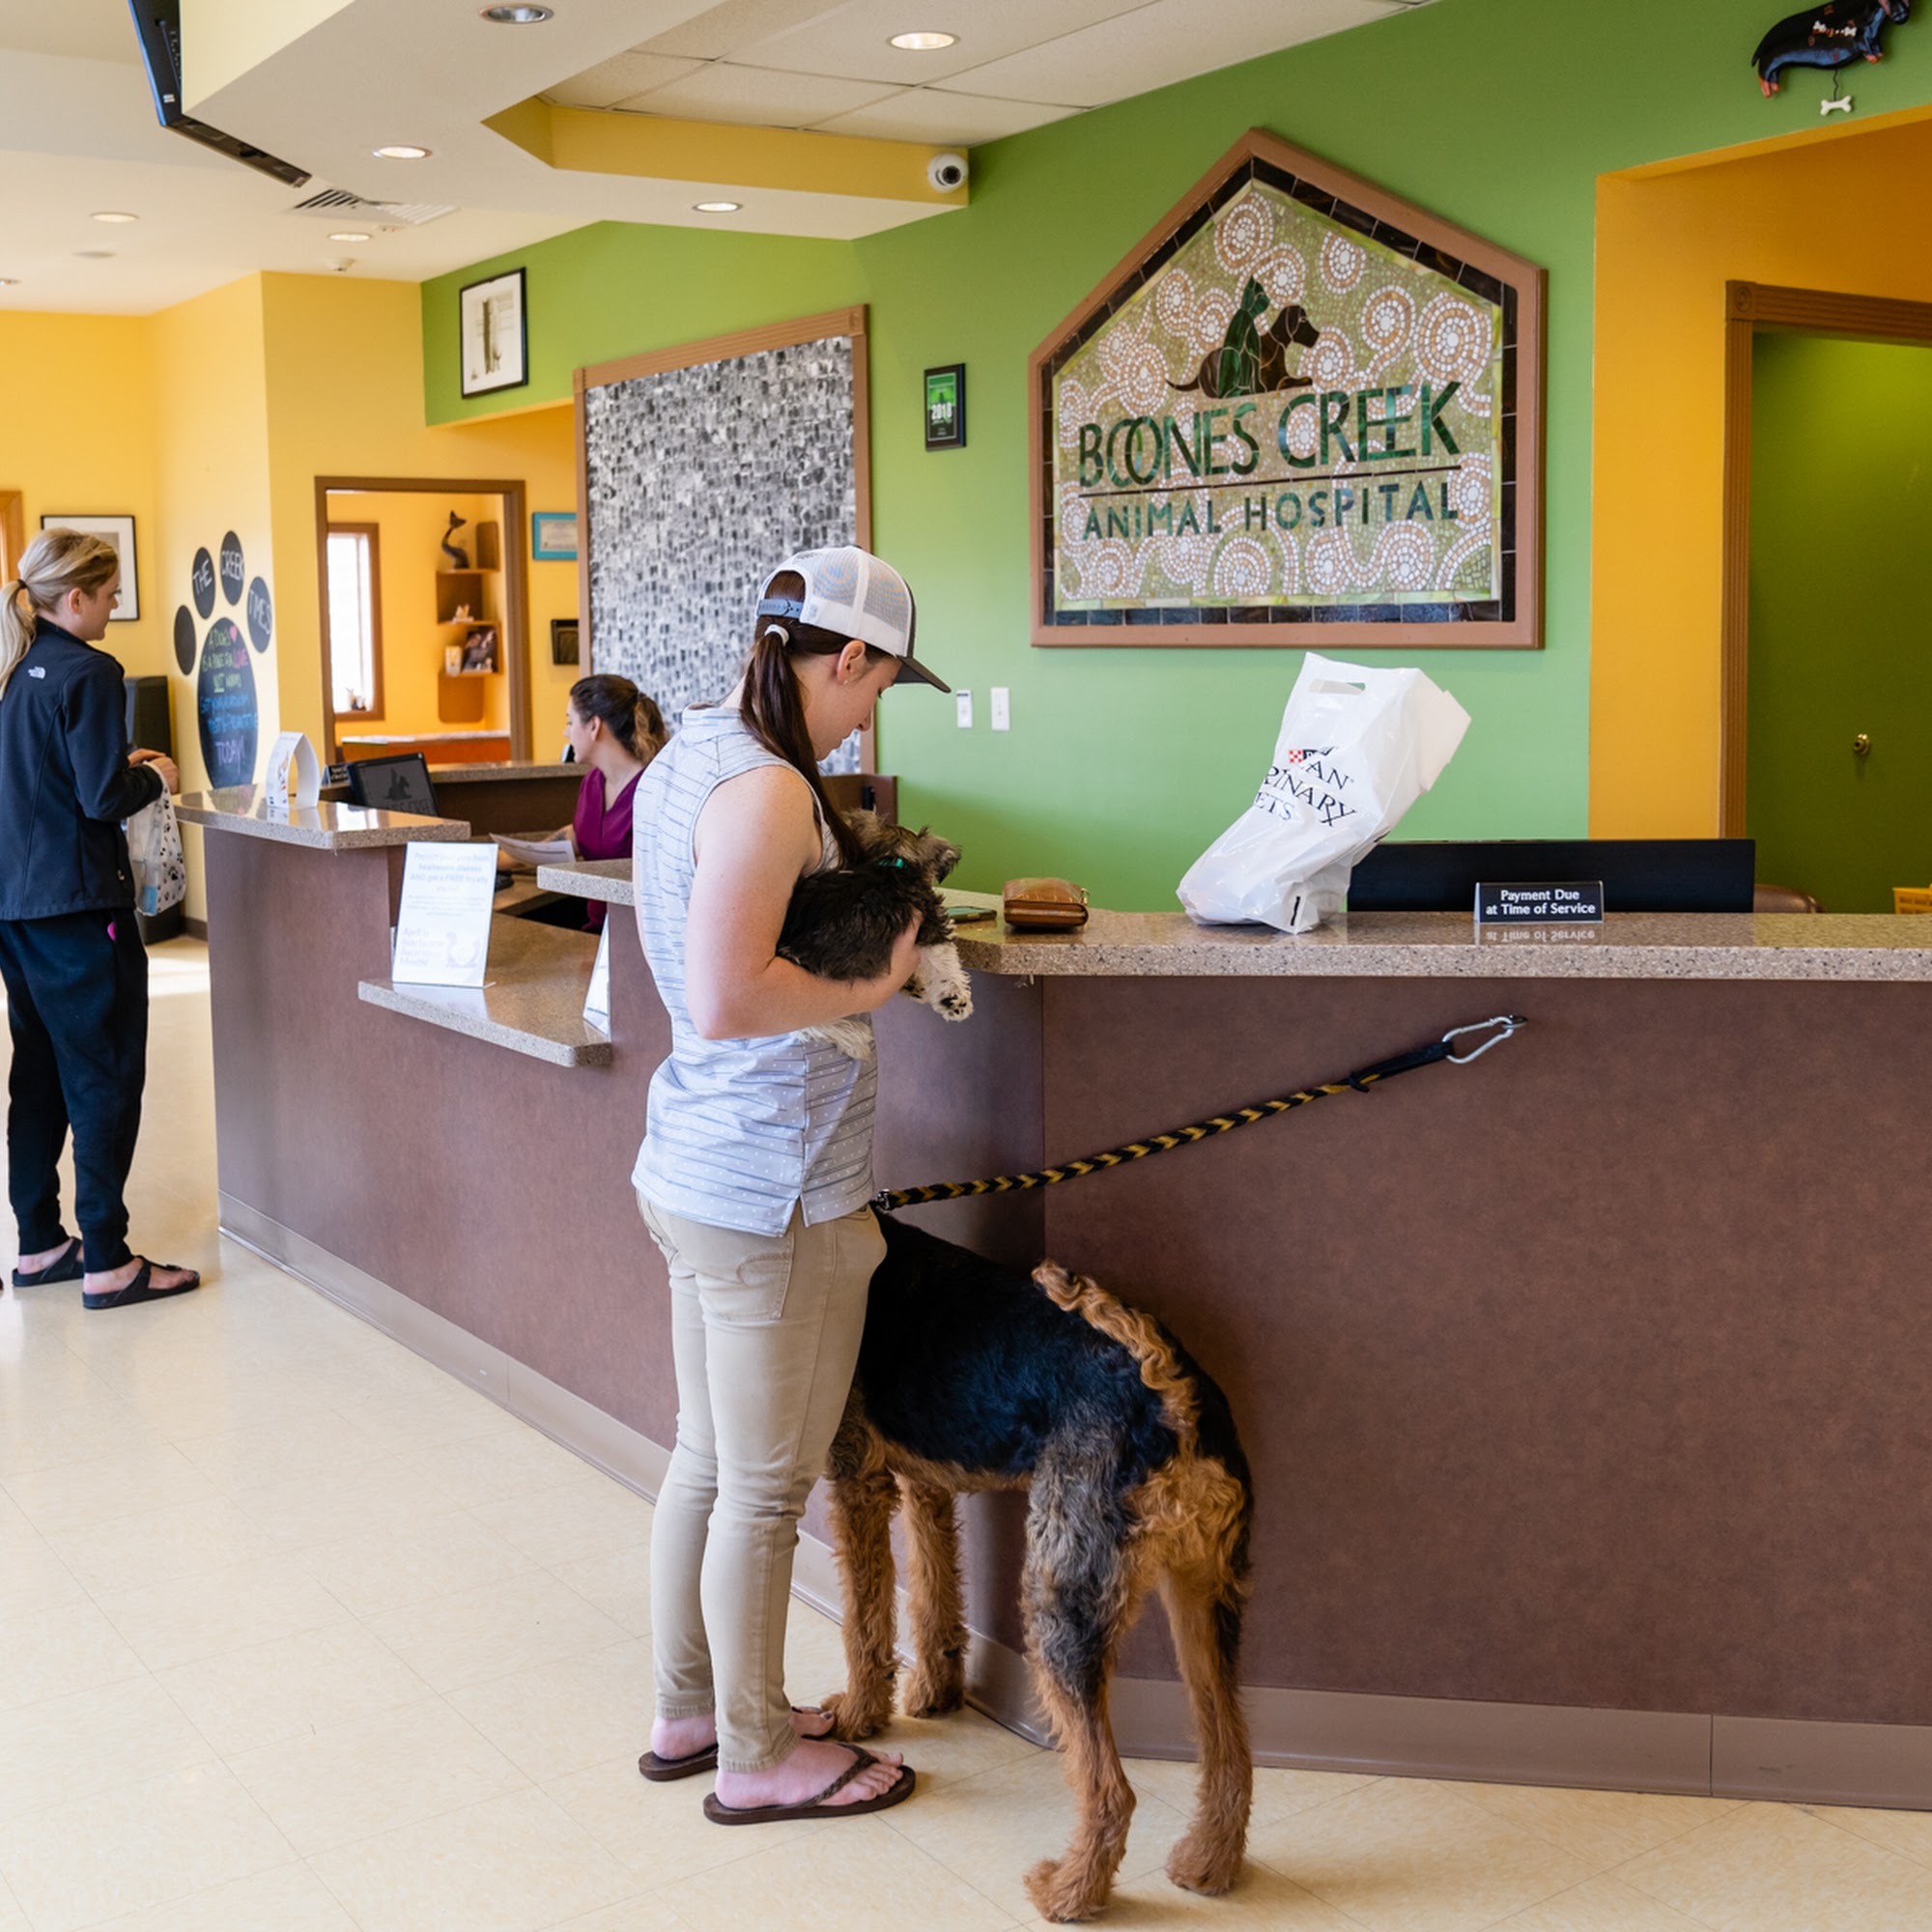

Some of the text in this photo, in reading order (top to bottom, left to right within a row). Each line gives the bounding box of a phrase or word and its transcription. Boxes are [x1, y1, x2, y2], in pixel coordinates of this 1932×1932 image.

[1079, 381, 1463, 487] BOONES CREEK
[1082, 480, 1459, 541] ANIMAL HOSPITAL
[193, 558, 213, 595] THE
[1486, 902, 1596, 915] at Time of Service
[1500, 889, 1579, 903] Payment Due
